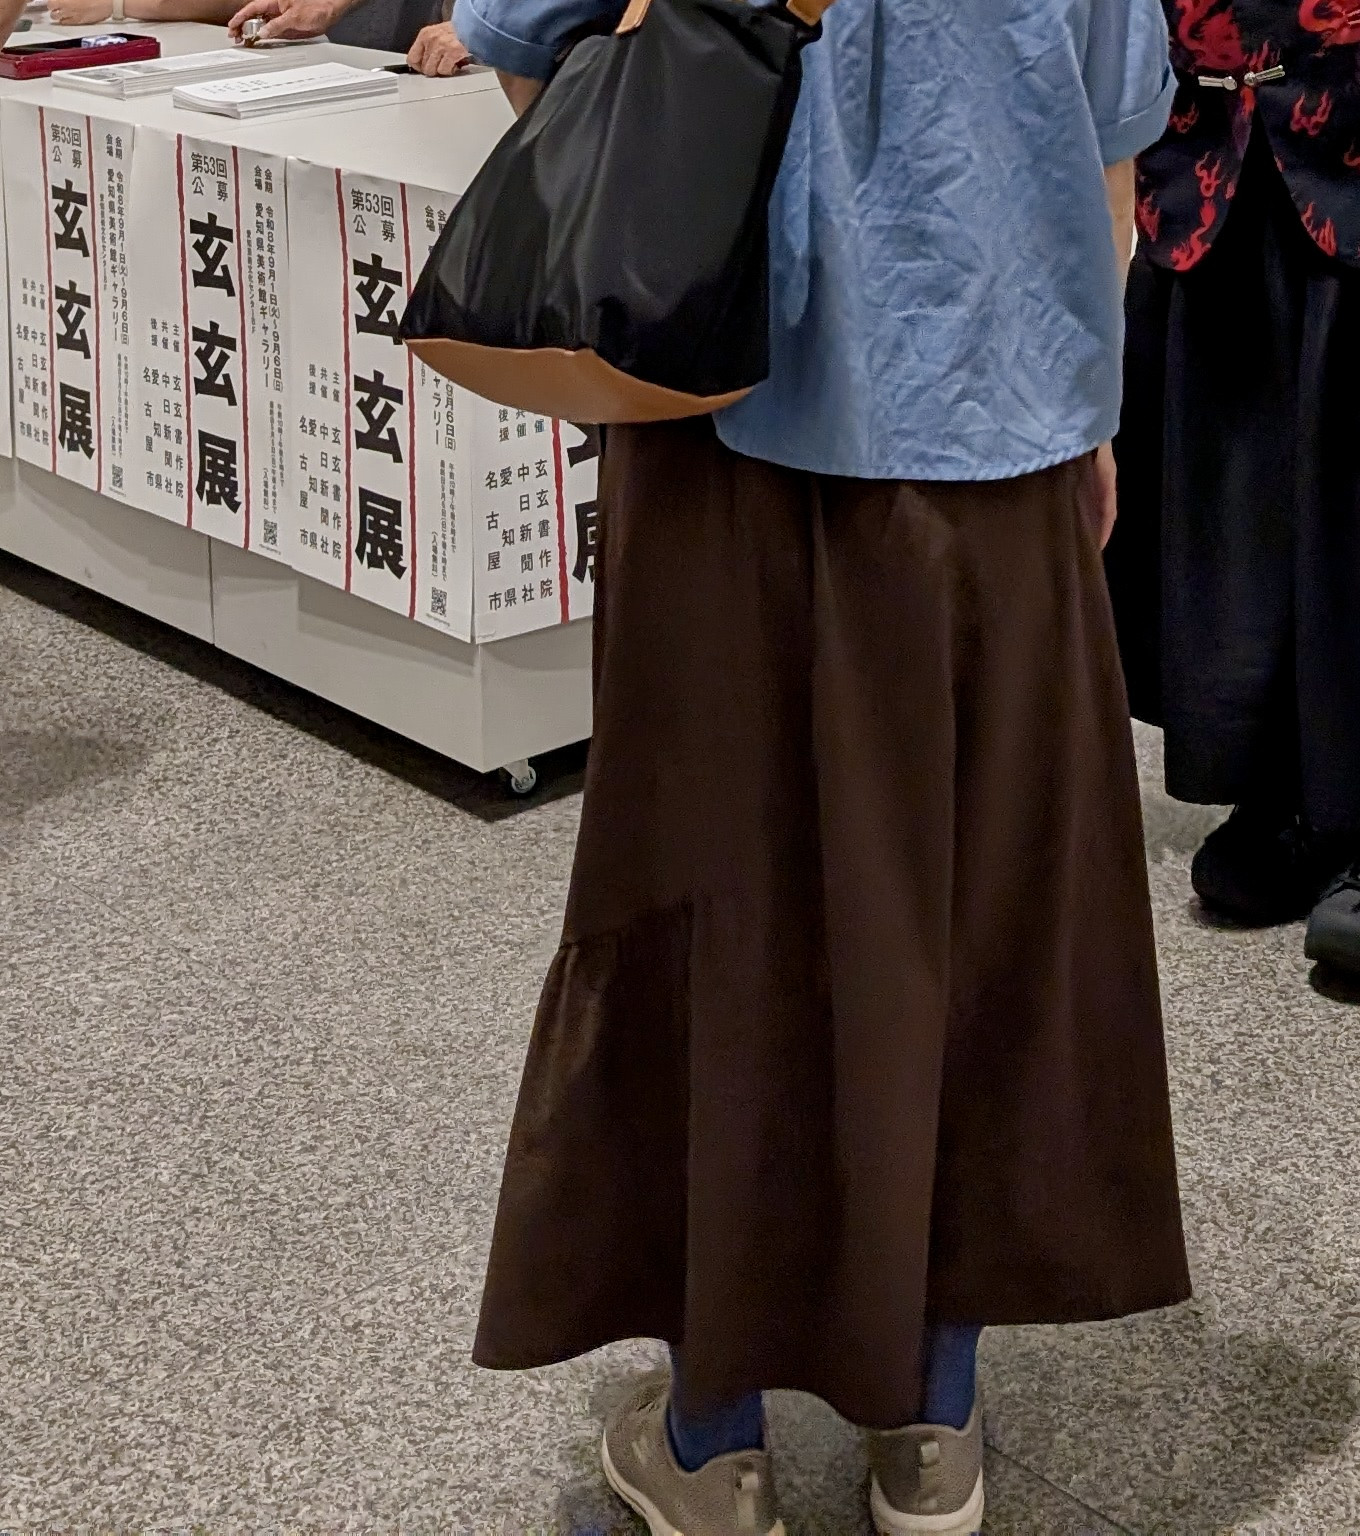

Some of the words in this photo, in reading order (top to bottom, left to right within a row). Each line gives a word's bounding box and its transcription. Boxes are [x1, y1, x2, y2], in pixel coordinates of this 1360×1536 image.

[51, 123, 82, 148] 第53回
[52, 145, 82, 169] 公募
[191, 152, 228, 179] 第53回
[192, 176, 229, 202] 公募
[350, 188, 394, 219] 第53回
[353, 214, 396, 243] 公募
[51, 178, 96, 460] 玄玄展
[190, 212, 242, 514] 玄玄展
[319, 367, 328, 399] 共催
[332, 371, 340, 402] 主催
[352, 253, 407, 580] 玄玄展
[498, 408, 510, 442] 後援
[298, 415, 309, 546] 名古屋市
[319, 422, 329, 555] 中日新聞社
[331, 425, 342, 559] 玄玄書作院
[485, 470, 503, 611] 名古屋市
[499, 465, 517, 607] 愛知県
[517, 463, 535, 603] 中日新聞社
[535, 458, 553, 599] 玄玄書作院
